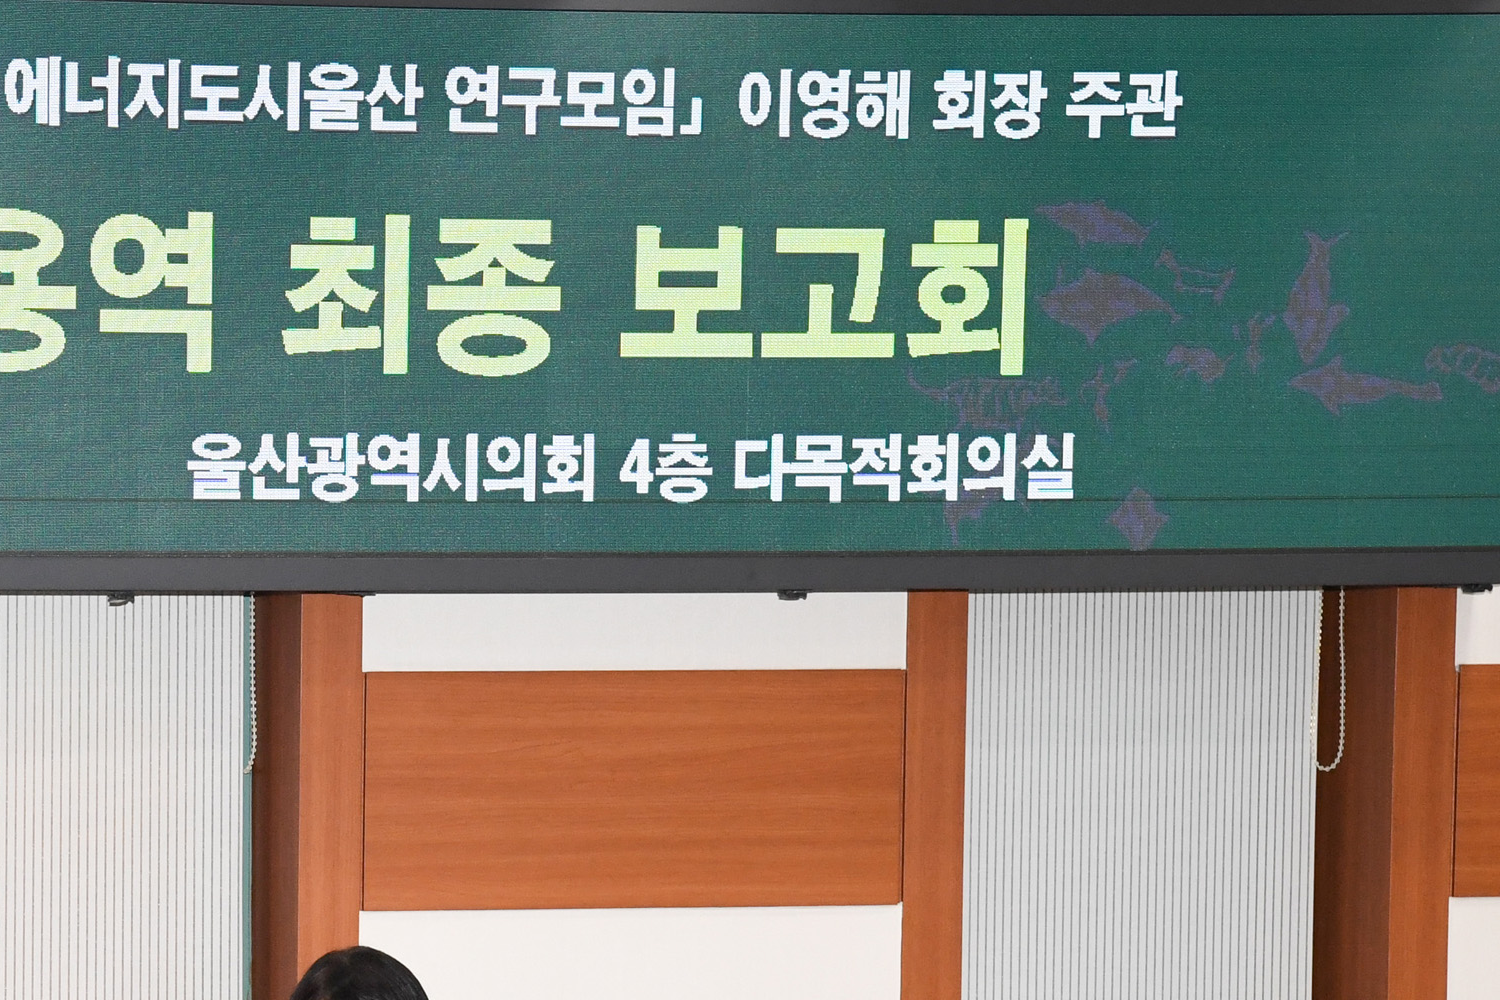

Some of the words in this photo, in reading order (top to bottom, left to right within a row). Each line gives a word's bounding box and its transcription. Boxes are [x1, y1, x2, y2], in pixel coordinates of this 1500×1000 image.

[445, 66, 701, 136] 연구모임」
[739, 69, 910, 138] 이영해
[933, 71, 1047, 139] 회장
[1066, 71, 1182, 138] 주관
[282, 215, 560, 376] 최종
[620, 219, 1028, 375] 보고회
[188, 433, 594, 501] 울산광역시의회
[620, 434, 712, 502] 4층
[735, 433, 1075, 502] 다목적회의실
